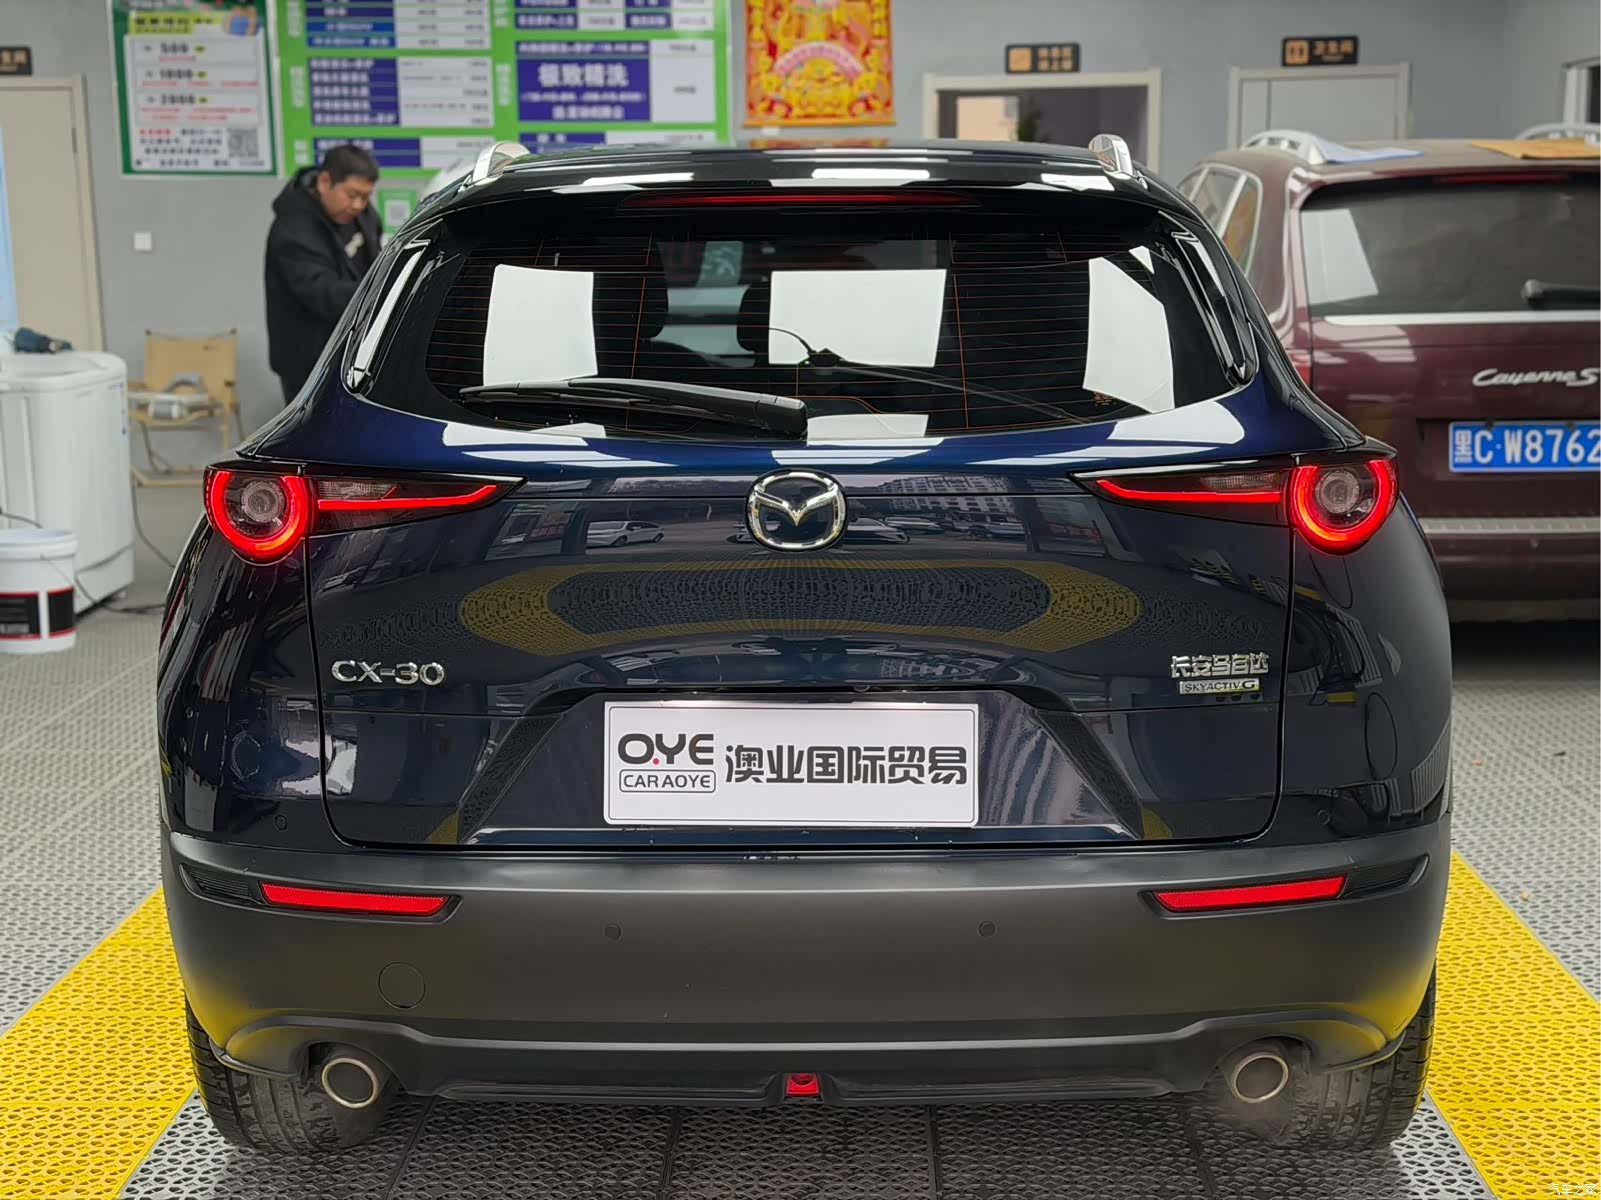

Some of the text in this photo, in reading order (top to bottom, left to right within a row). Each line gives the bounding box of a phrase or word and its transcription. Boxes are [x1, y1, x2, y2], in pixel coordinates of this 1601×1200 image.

[331, 660, 445, 686] CX-30
[1170, 651, 1269, 679] 长安马自达
[725, 744, 968, 785] 澳业国际贸易
